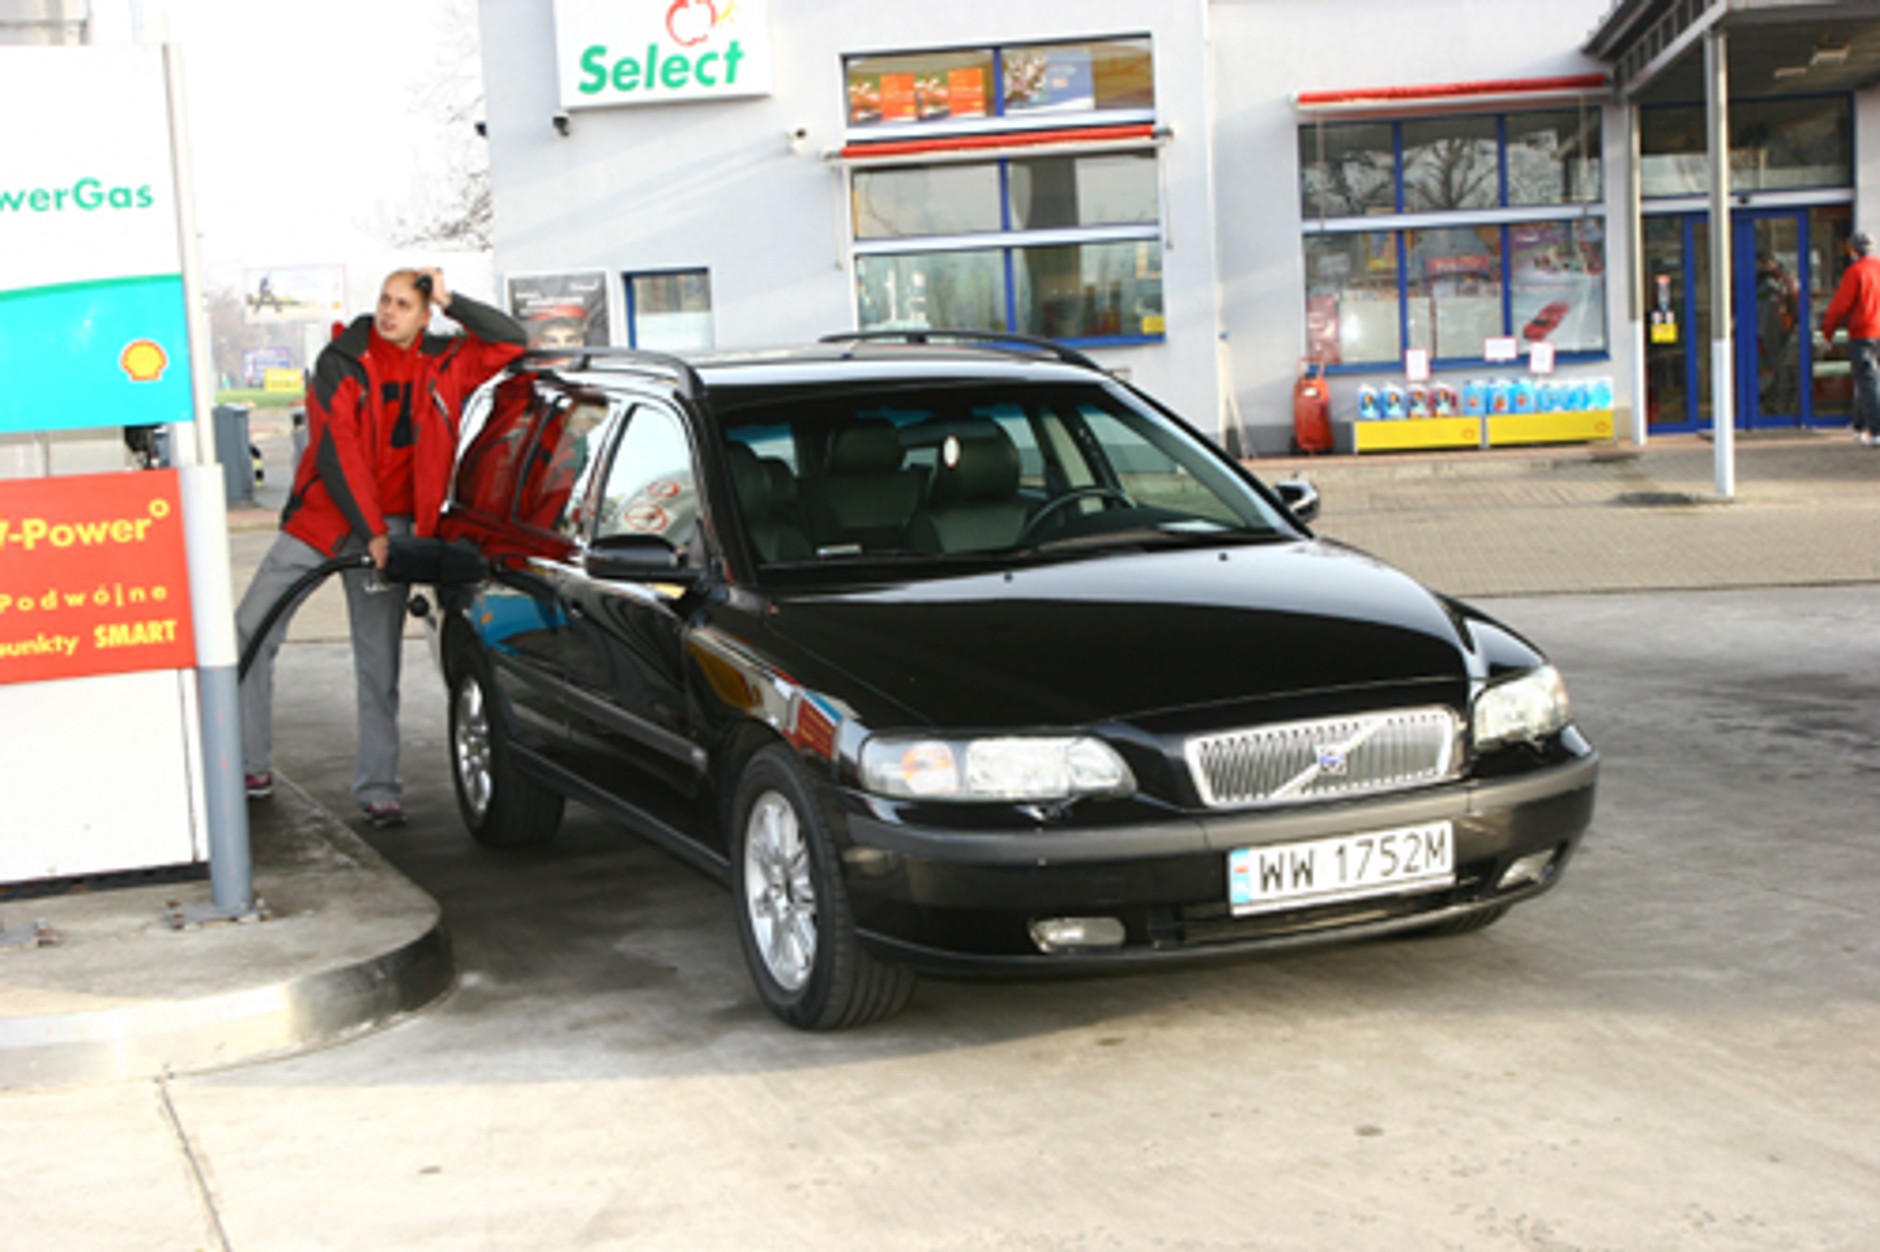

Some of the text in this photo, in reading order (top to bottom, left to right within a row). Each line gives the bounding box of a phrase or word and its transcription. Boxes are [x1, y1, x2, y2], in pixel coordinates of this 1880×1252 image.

[577, 40, 744, 94] Select
[94, 619, 177, 649] SMART
[1259, 827, 1446, 893] WW 1752M
